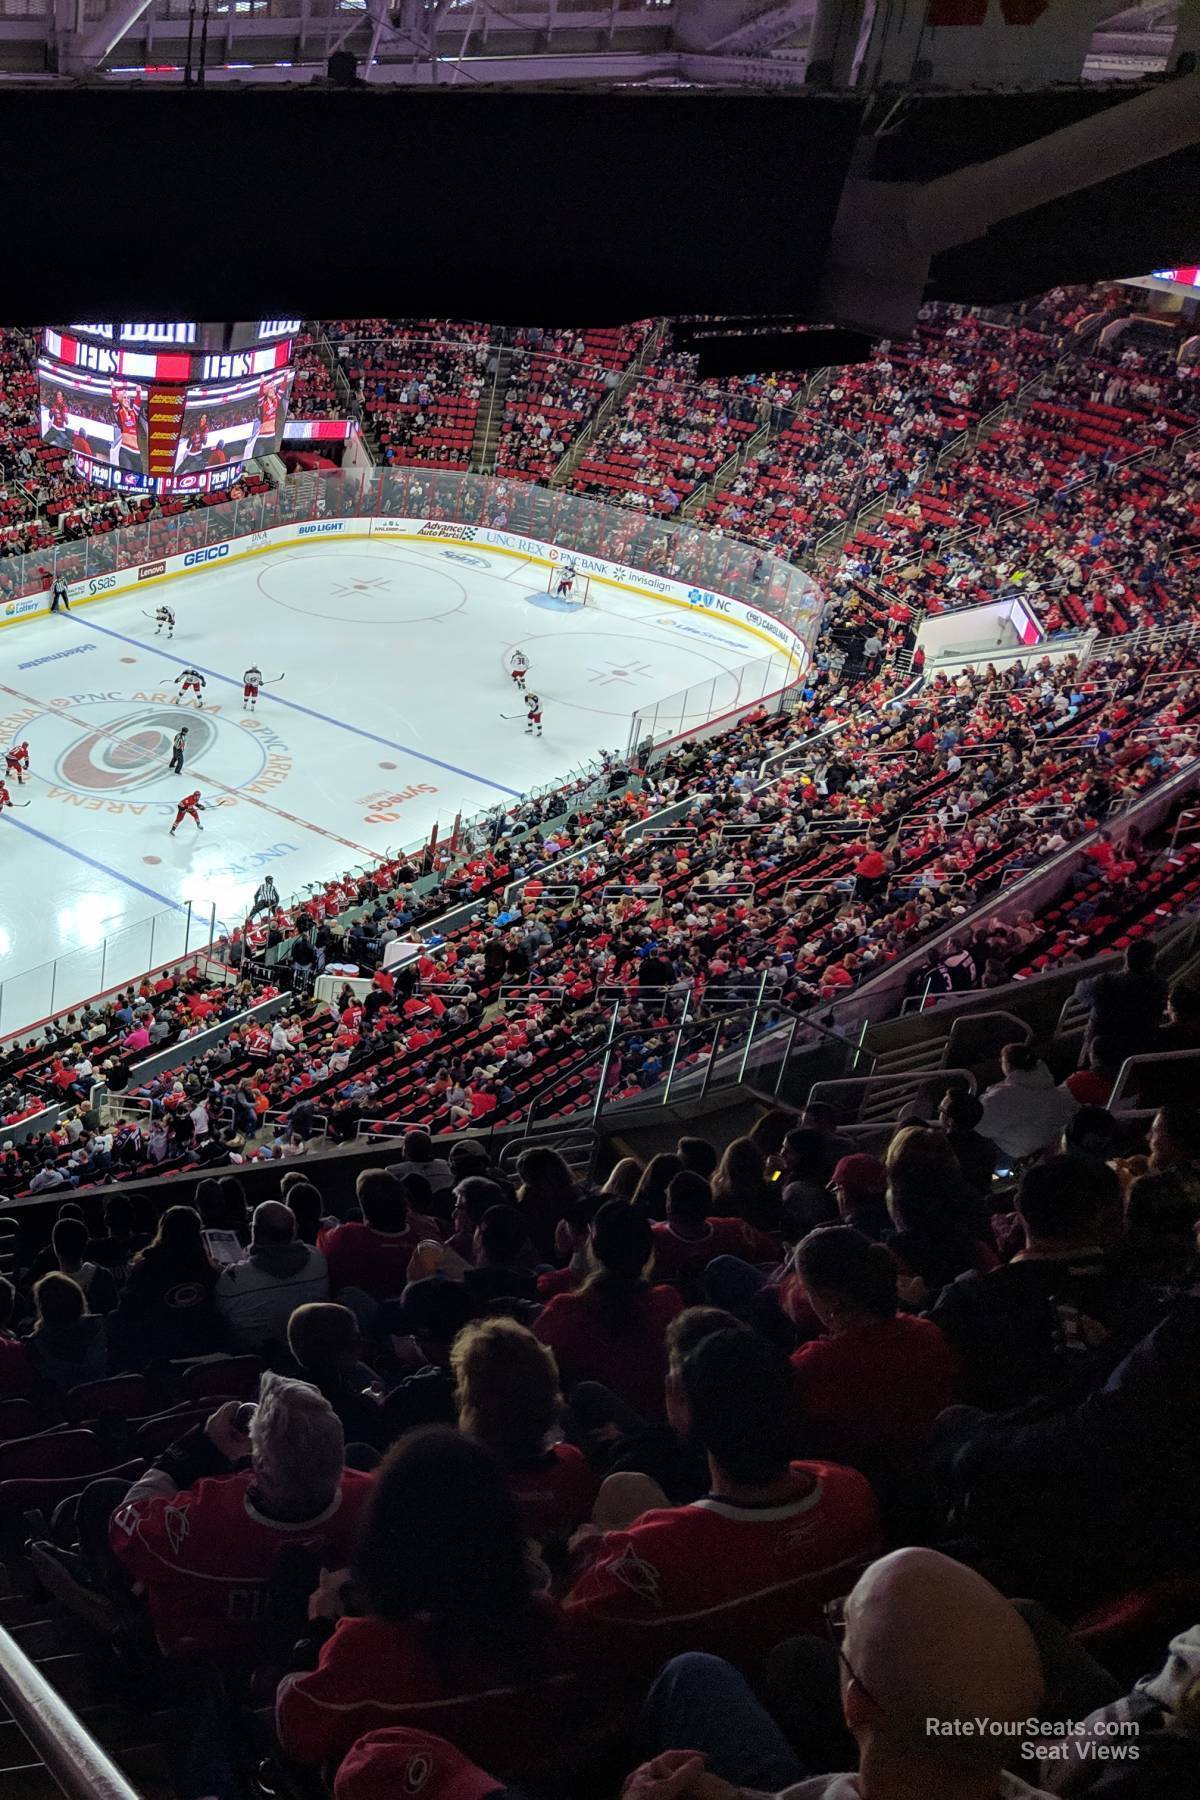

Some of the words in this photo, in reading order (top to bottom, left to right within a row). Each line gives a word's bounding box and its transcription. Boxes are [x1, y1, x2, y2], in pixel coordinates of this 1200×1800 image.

[299, 525, 317, 535] BUD
[318, 522, 343, 533] LIGHT
[417, 529, 438, 538] Auto
[438, 530, 461, 540] Parts
[423, 521, 463, 533] Advance
[184, 544, 229, 566] GEICO
[486, 532, 514, 548] UNC
[519, 539, 545, 557] REX
[140, 565, 165, 578] Lenovo
[629, 571, 671, 592] invisalign
[16, 602, 39, 614] Lottery
[716, 599, 732, 613] NC
[762, 620, 789, 644] CAROLINAS
[71, 692, 123, 704] PNC
[253, 726, 288, 753] PNC
[244, 753, 293, 794] ARENA
[47, 787, 149, 818] ARENA
[368, 783, 439, 812] Syneos
[250, 842, 299, 867] UNC
